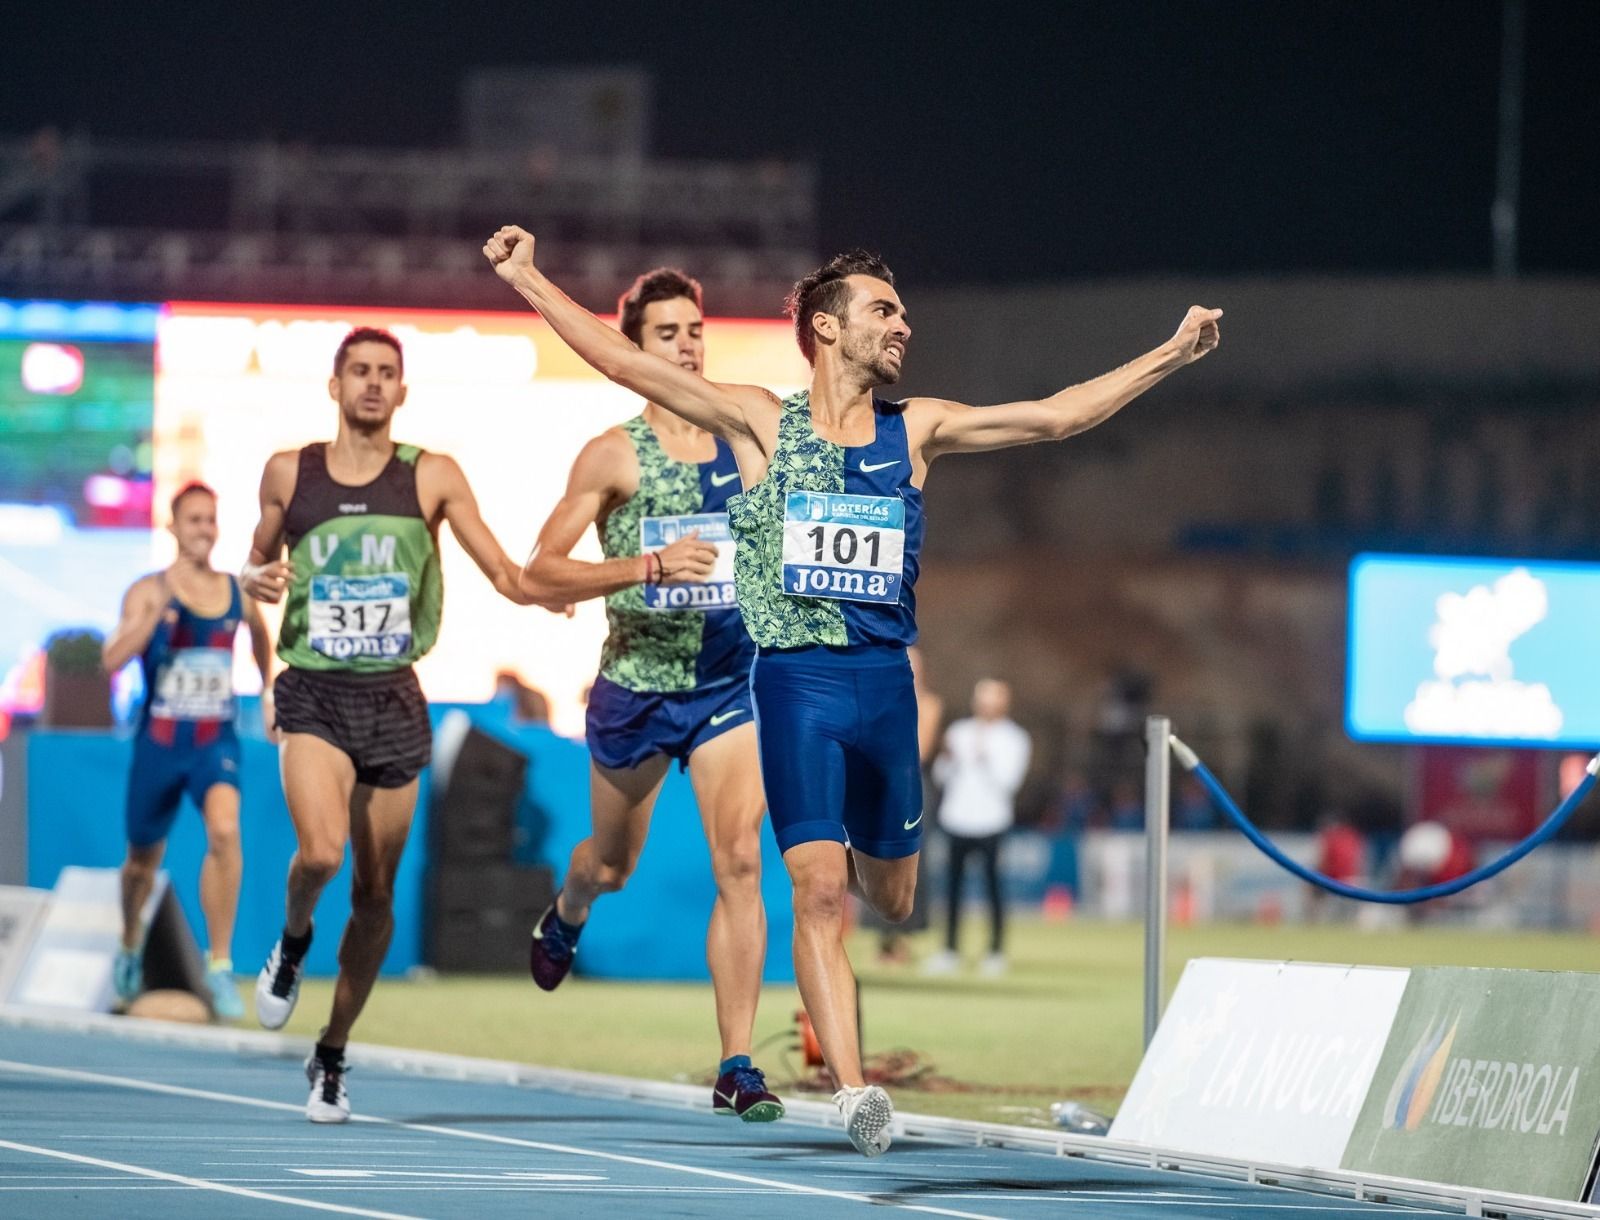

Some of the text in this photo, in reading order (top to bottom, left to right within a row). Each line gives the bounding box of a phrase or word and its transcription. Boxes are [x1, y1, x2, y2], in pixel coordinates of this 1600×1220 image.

[832, 503, 889, 516] LOTERÍAS
[309, 533, 397, 569] U M
[807, 526, 881, 567] 101
[328, 603, 392, 633] 317
[1431, 1057, 1581, 1137] IBERDROLA
